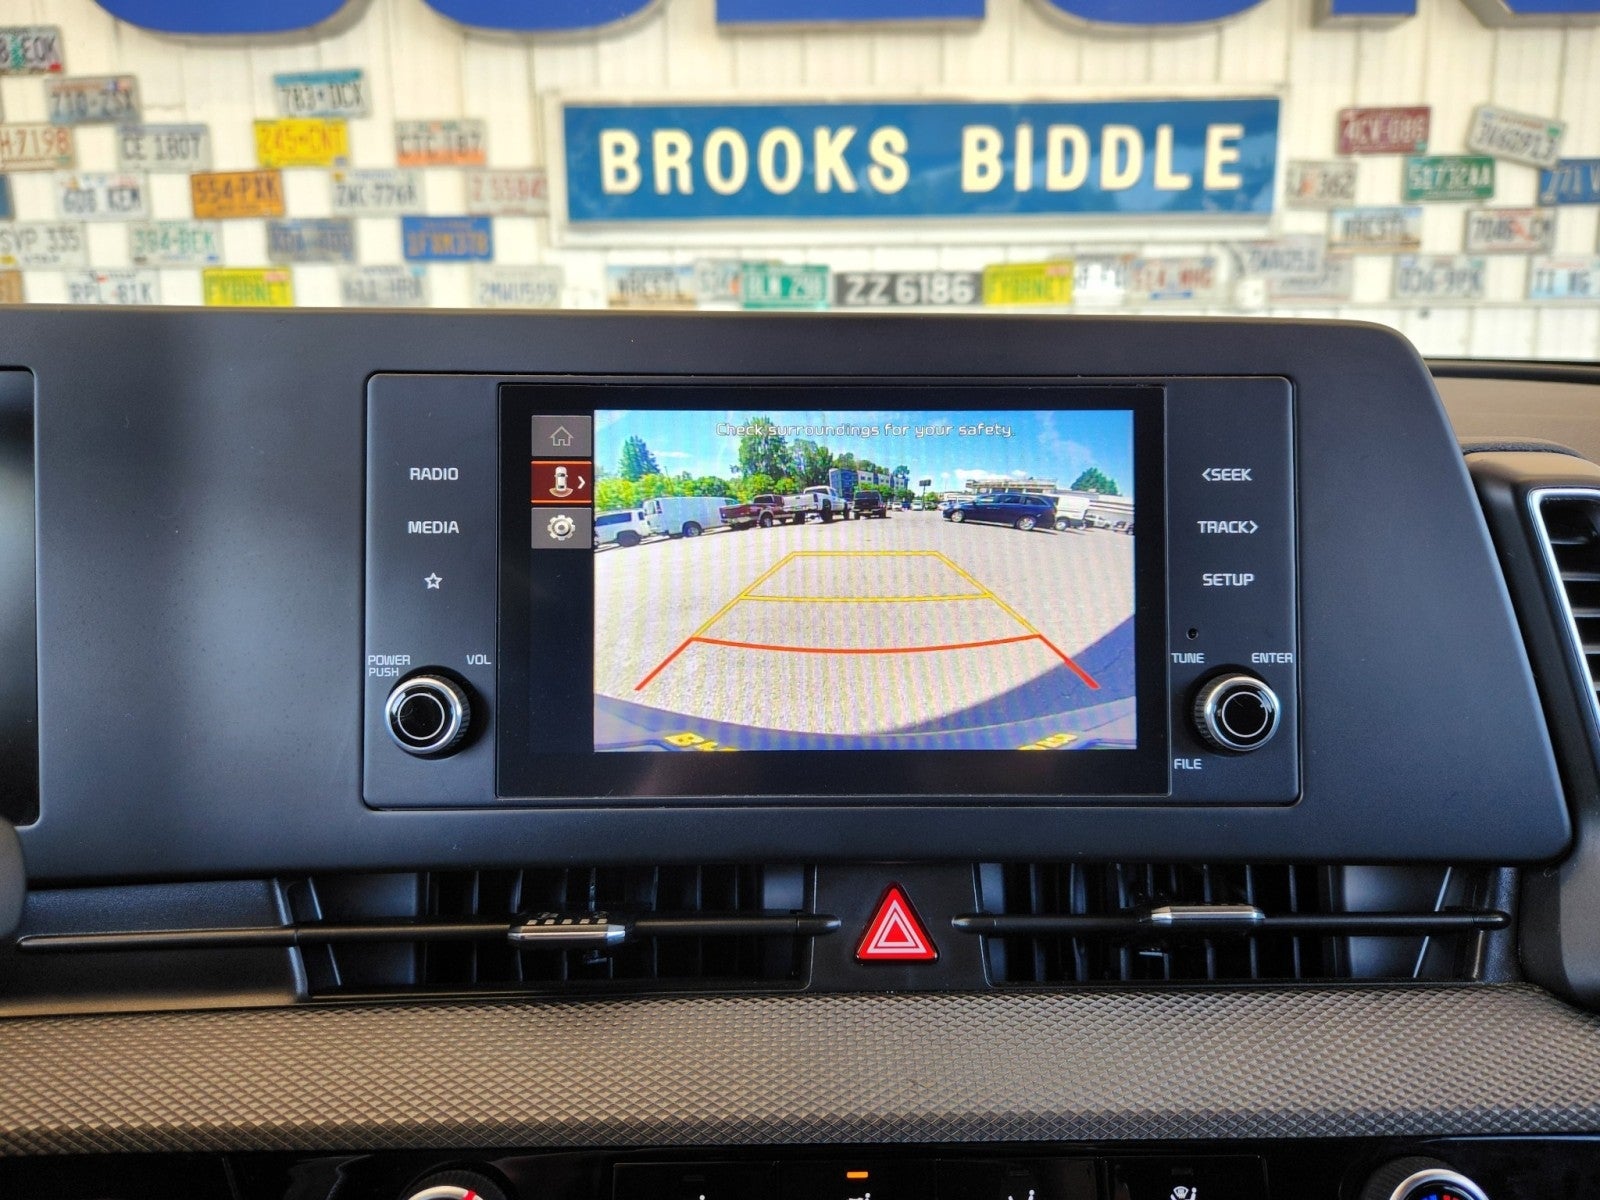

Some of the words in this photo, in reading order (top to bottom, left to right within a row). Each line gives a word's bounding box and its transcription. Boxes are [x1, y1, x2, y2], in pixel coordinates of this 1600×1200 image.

[599, 127, 910, 195] BROOKS
[961, 124, 1244, 192] BIDDLE
[844, 275, 891, 304] ZZ
[894, 274, 976, 304] 6186
[715, 422, 763, 436] Check
[767, 422, 879, 438] surroundings
[884, 422, 908, 436] for
[914, 424, 952, 438] your
[958, 422, 1016, 438] safety.
[409, 466, 460, 481] RADIO
[407, 520, 460, 534] MEDIA
[1202, 573, 1255, 587] SETUP
[367, 654, 411, 666] POWER
[466, 654, 492, 665] VOL
[1171, 652, 1205, 664] TUNE
[1251, 652, 1294, 664] ENTER
[368, 667, 400, 677] PUSH
[1173, 758, 1202, 770] FILE
